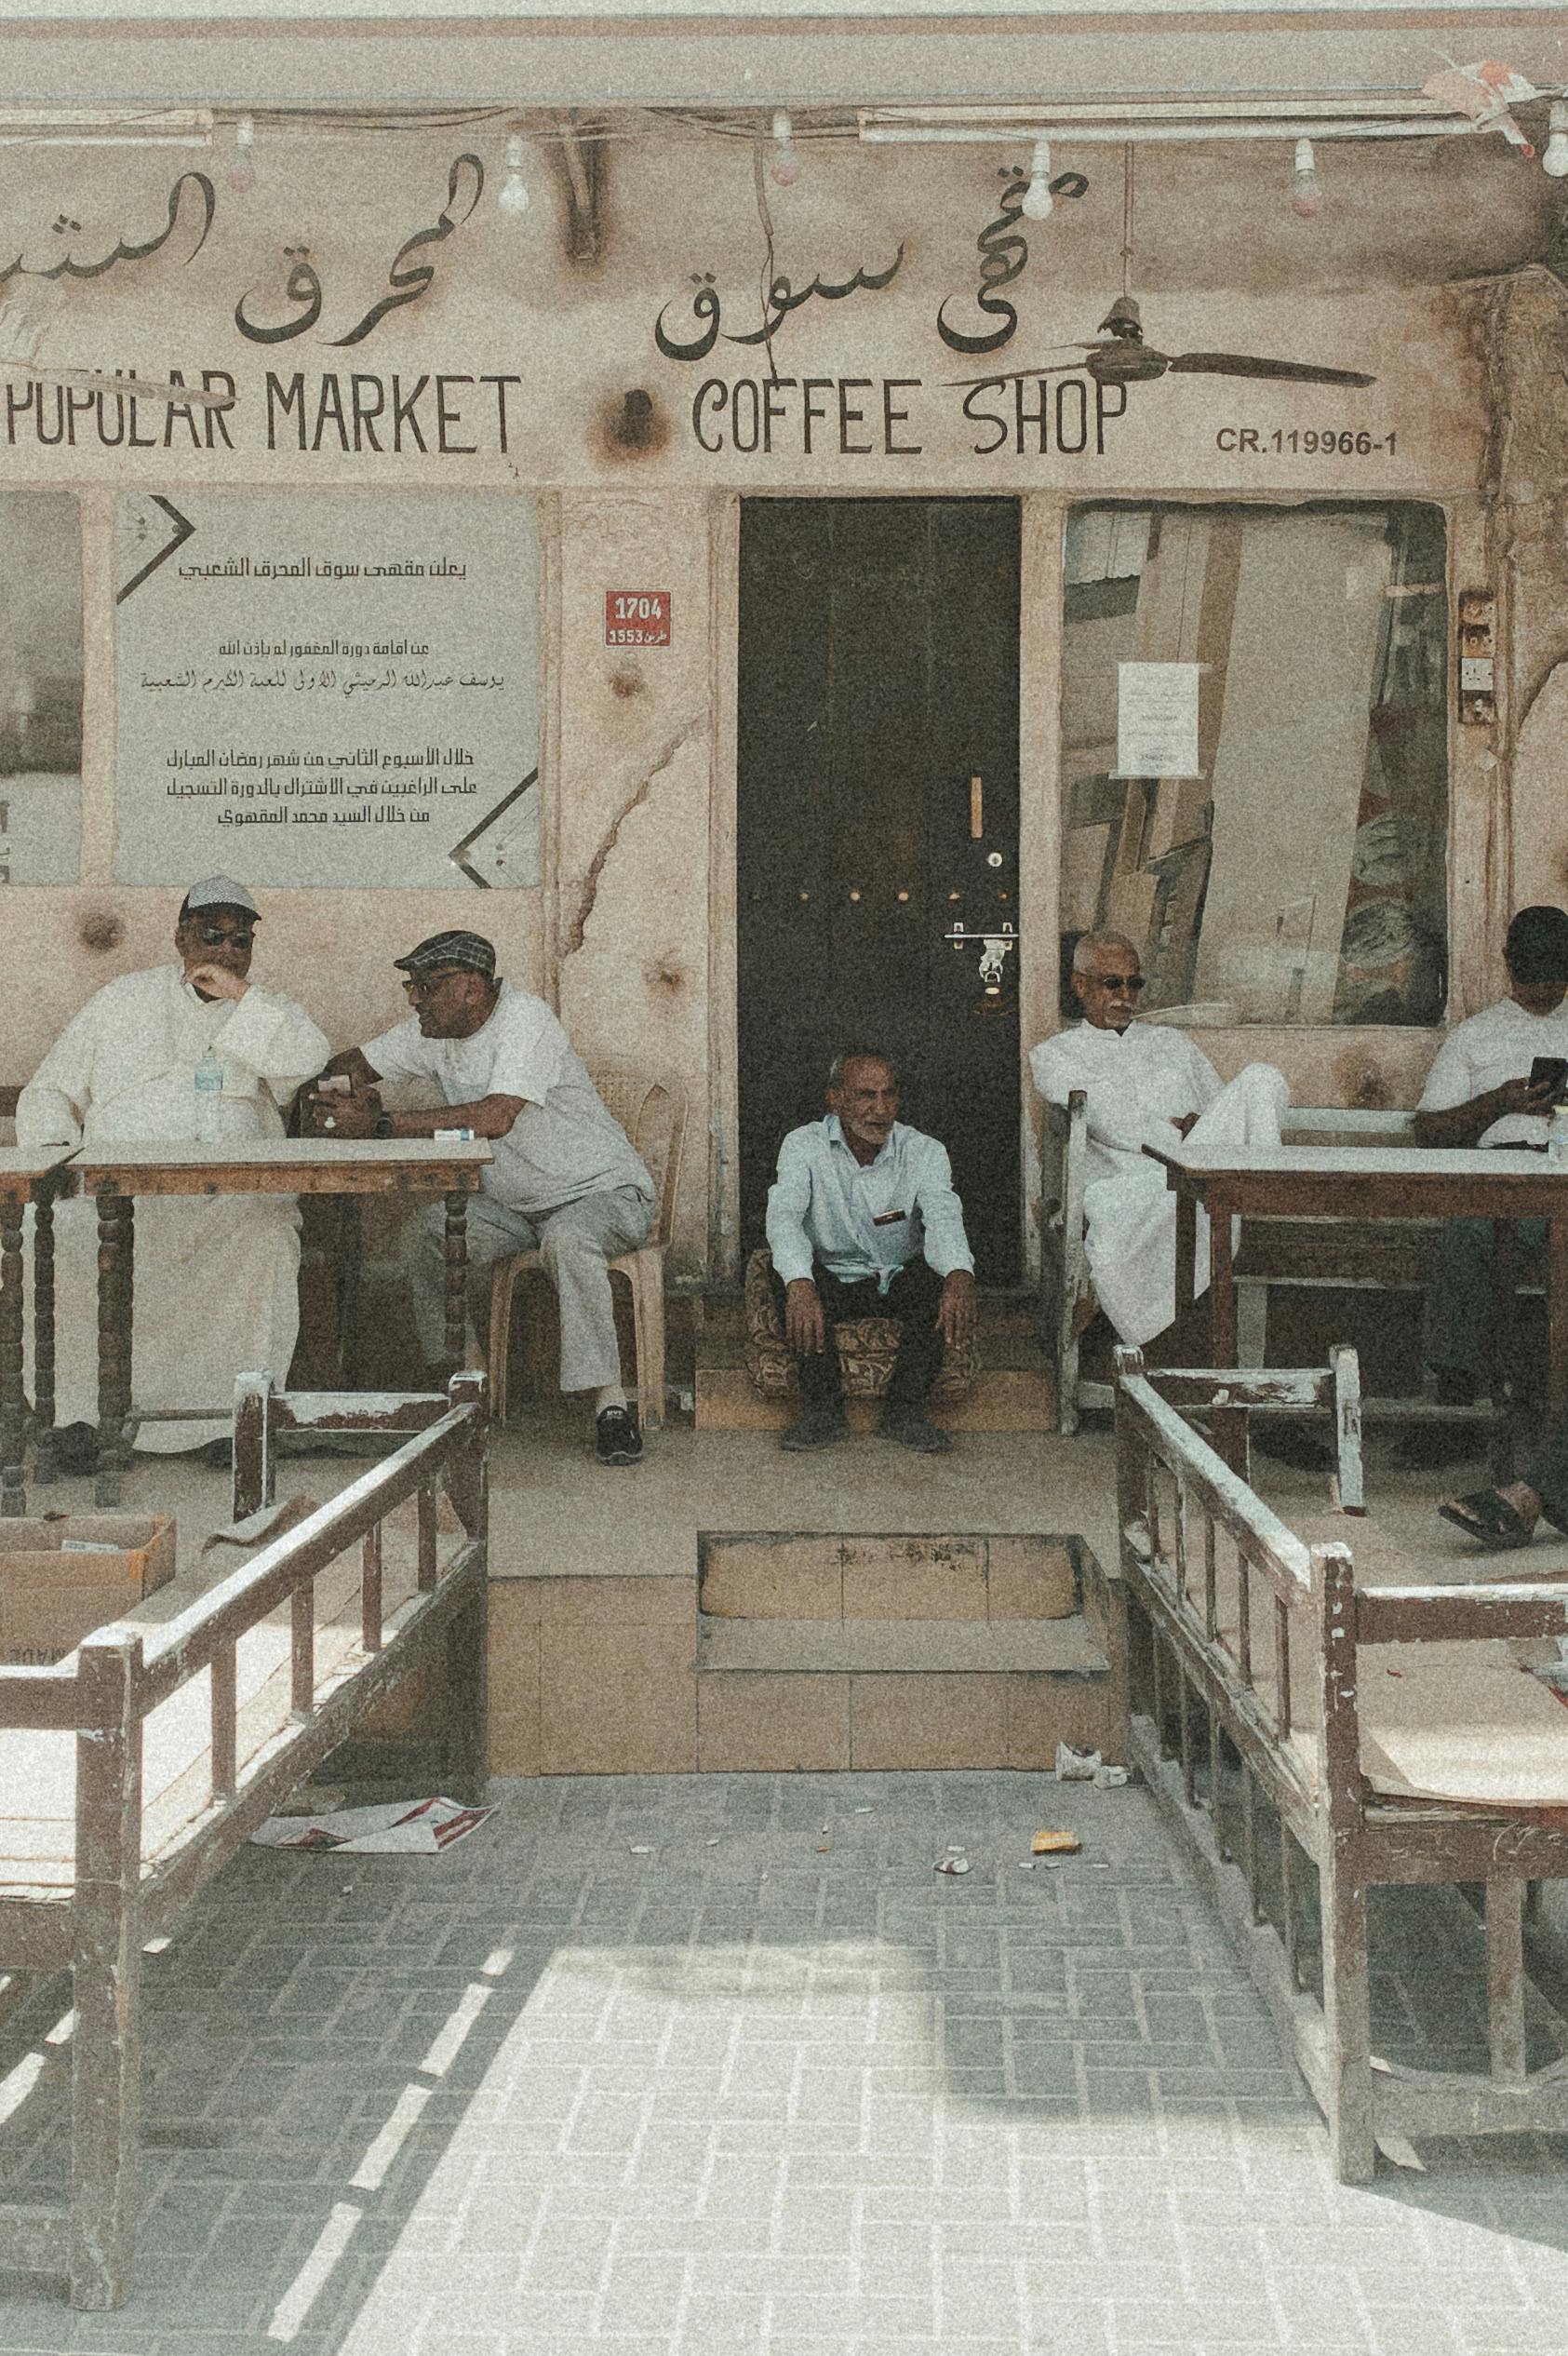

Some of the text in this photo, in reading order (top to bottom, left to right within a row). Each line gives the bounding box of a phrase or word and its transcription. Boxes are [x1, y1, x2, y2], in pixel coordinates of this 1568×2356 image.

[235, 153, 485, 347] المحرق
[654, 240, 905, 361] سوق
[6, 369, 1127, 455] POPULAR MARKET COFFEE SHOP
[1215, 427, 1397, 456] CR.119966-1
[179, 556, 249, 580] الشعبي
[254, 557, 311, 580] المحرق
[315, 560, 360, 580] سوق
[429, 557, 467, 581] يعلن
[615, 597, 662, 620] 1704
[218, 639, 240, 655] الله
[274, 639, 287, 655] له
[609, 630, 643, 643] 1553
[290, 639, 339, 657] المغفور
[342, 642, 370, 657] دورة
[410, 642, 430, 655] عن
[141, 670, 196, 692] الشعبية
[459, 671, 504, 692] يوسف
[167, 748, 215, 771] المبارك
[219, 748, 262, 769] رمضان
[266, 748, 300, 769] شهر
[303, 751, 325, 766] من
[328, 748, 378, 770] الثاني
[443, 748, 475, 765] خلال
[167, 777, 227, 799] التسجيل
[232, 777, 281, 799] بالدورة
[346, 779, 378, 799] في
[381, 776, 437, 798] الراغبين
[441, 776, 477, 794] على
[218, 805, 430, 828] من خلال السيد محمد المقهوي
